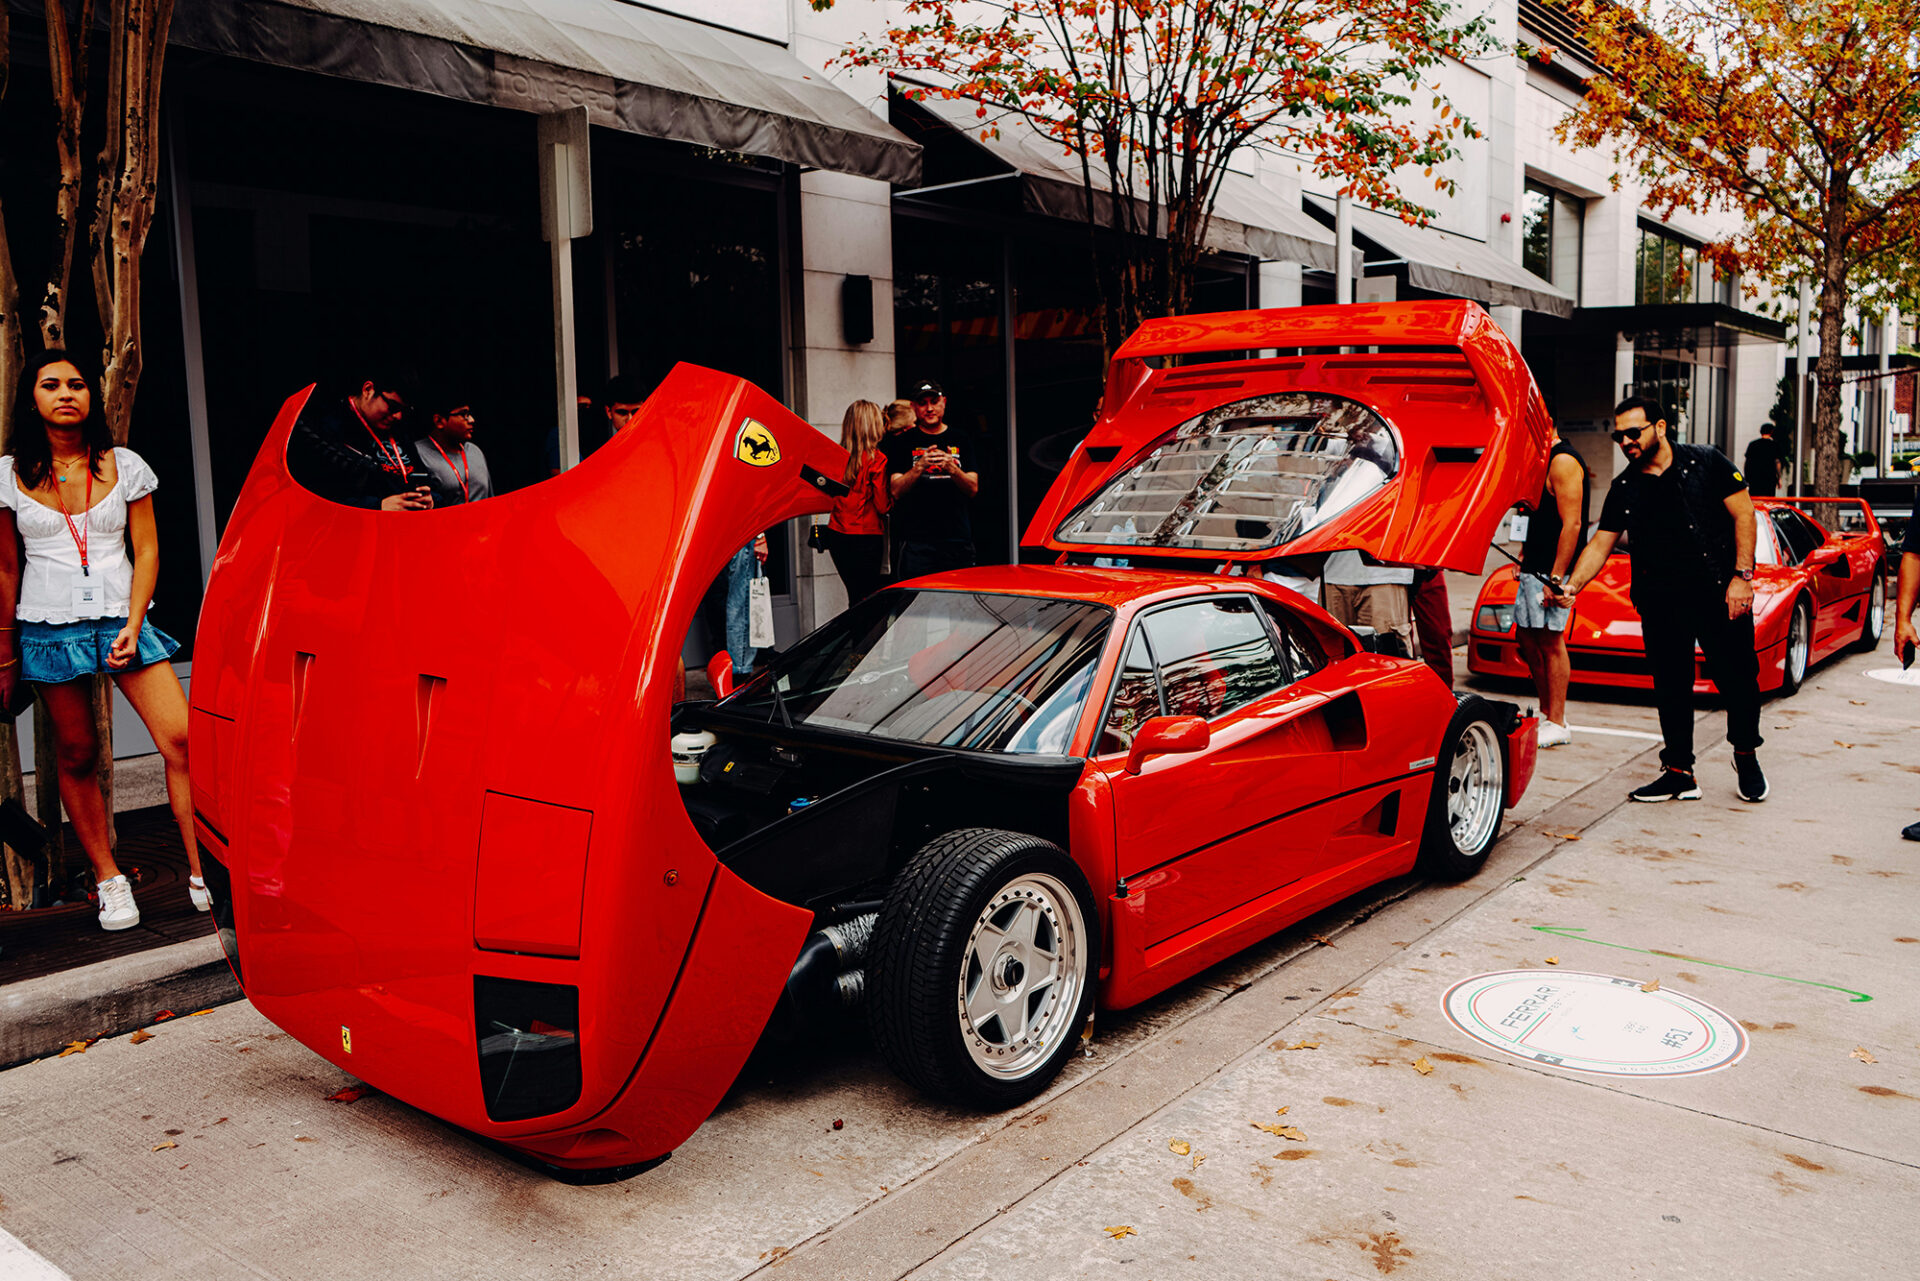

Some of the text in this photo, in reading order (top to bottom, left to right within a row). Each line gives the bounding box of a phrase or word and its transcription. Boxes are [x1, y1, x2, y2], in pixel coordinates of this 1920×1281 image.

[495, 70, 616, 112] TOM FORD
[1500, 985, 1560, 1029] FERRARI
[1661, 1028, 1693, 1048] #51
